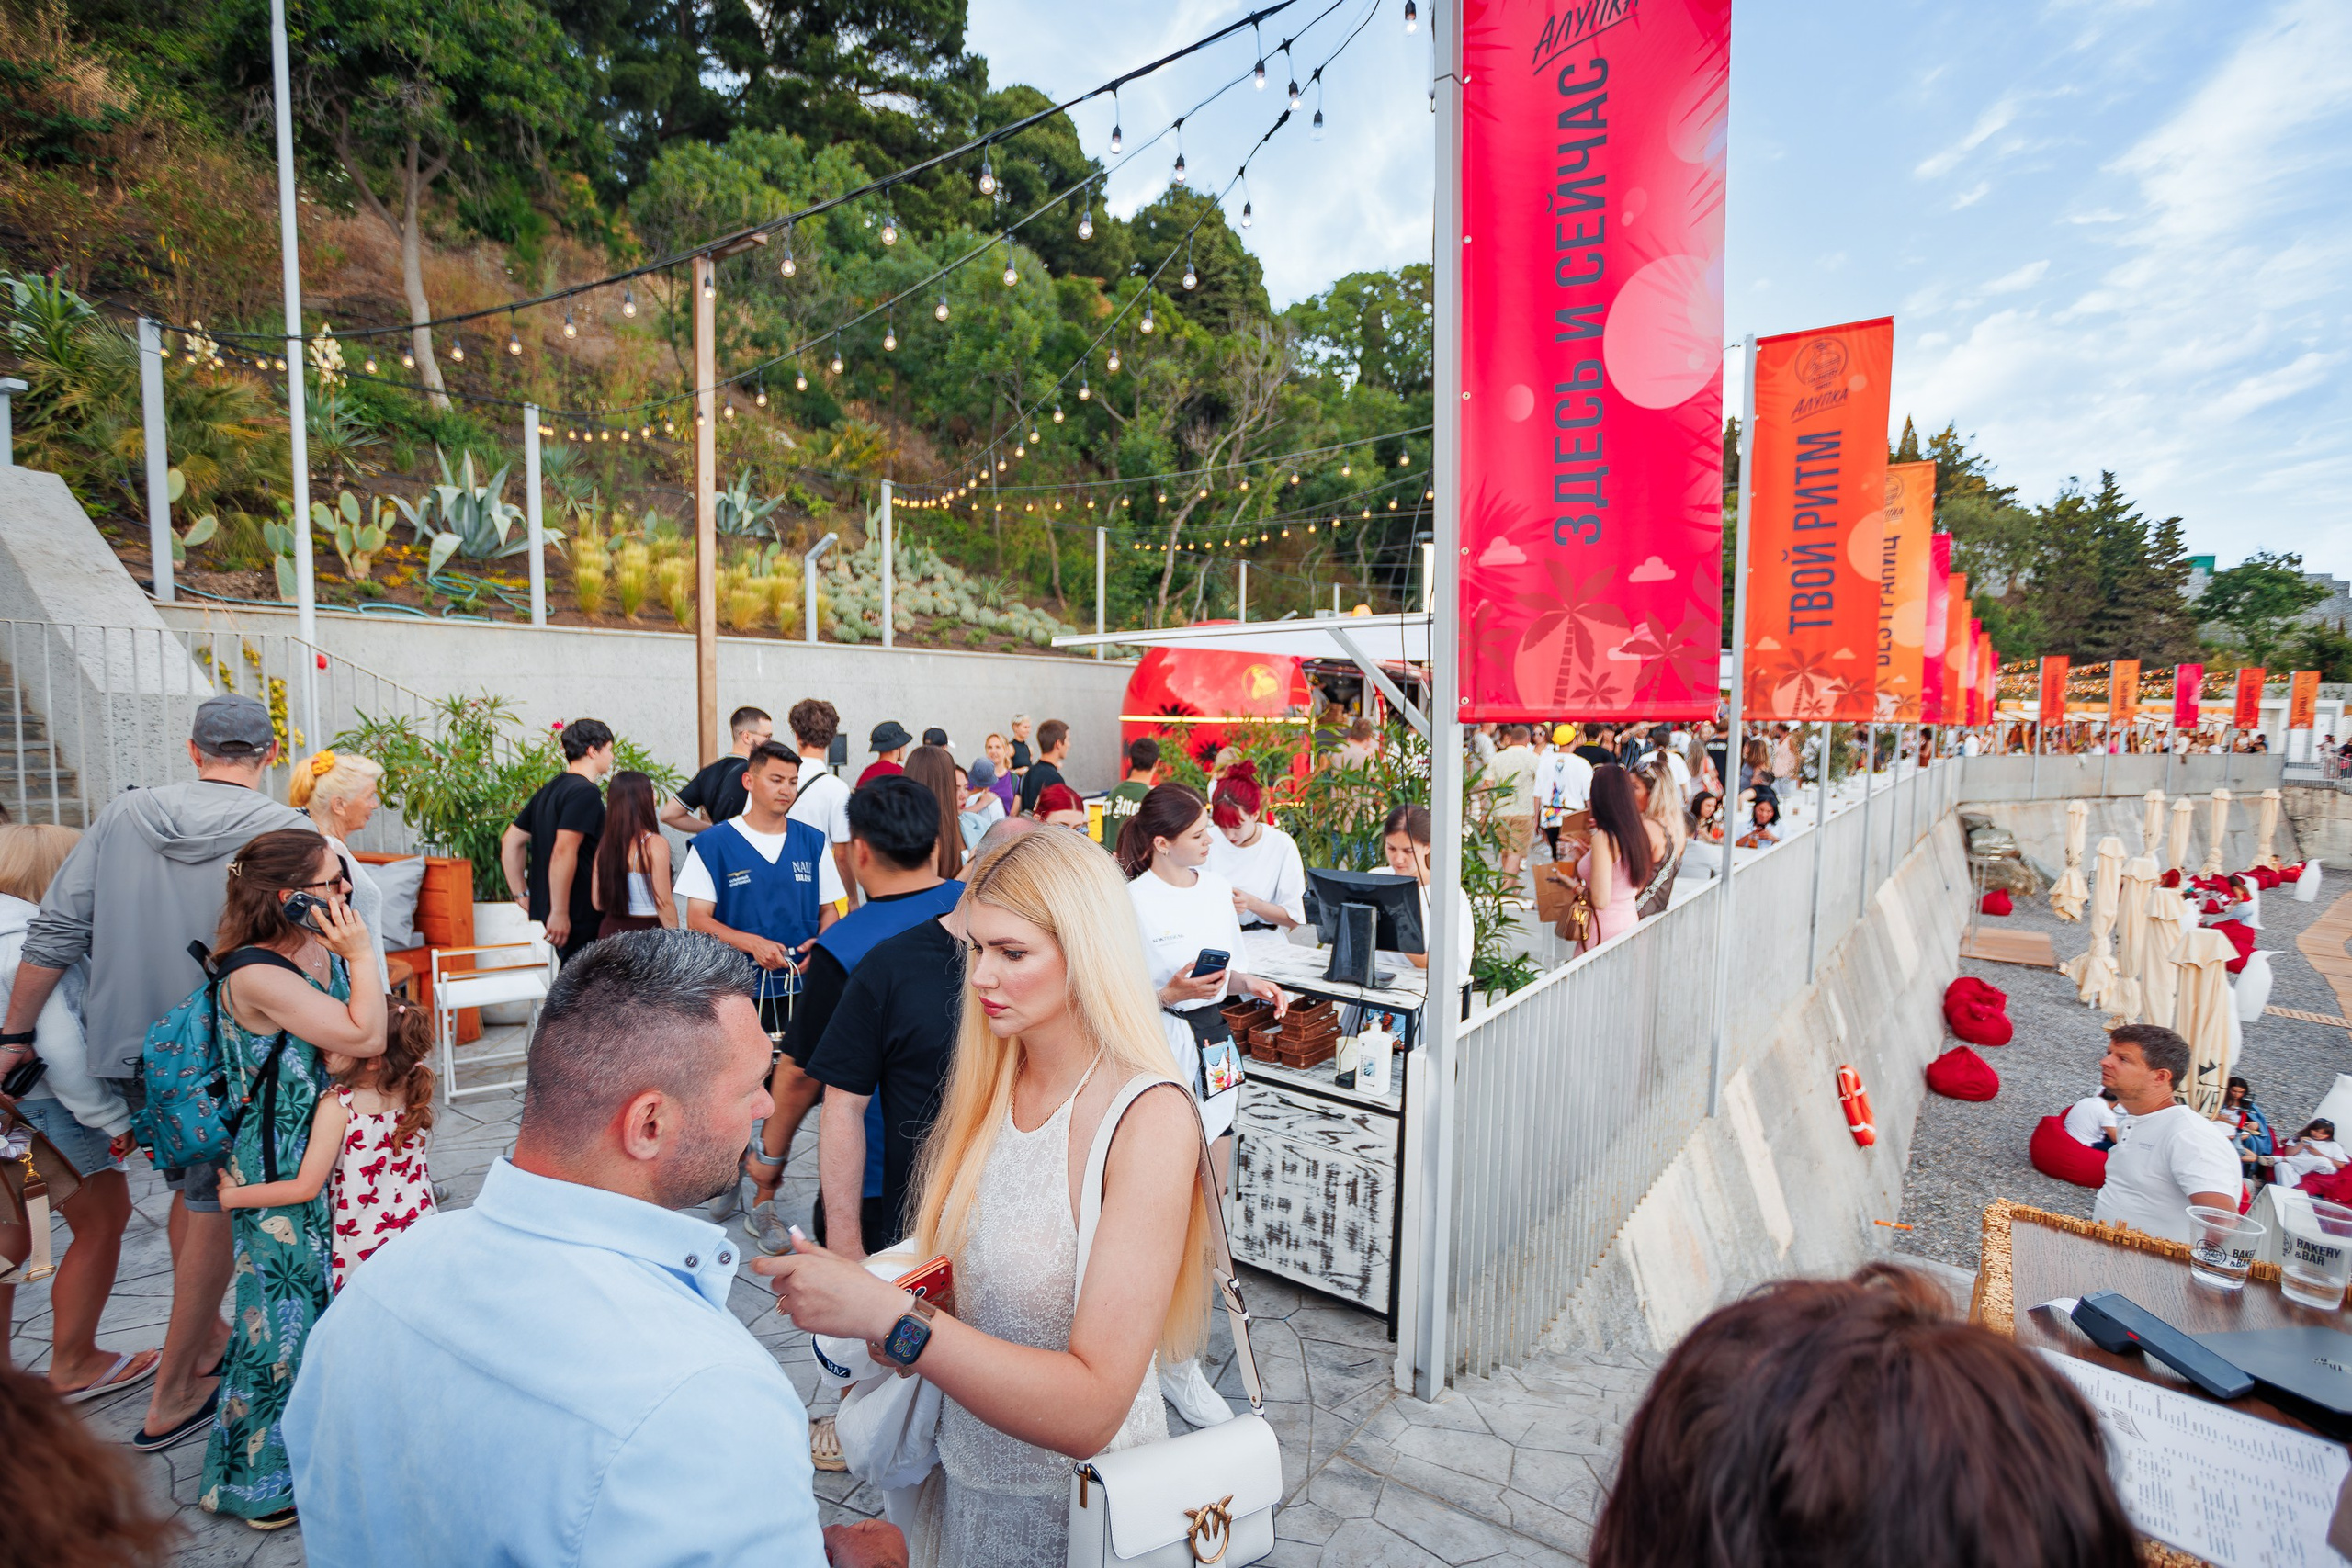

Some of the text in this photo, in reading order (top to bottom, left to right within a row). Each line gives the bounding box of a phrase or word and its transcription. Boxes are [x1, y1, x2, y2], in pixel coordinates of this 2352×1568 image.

[1546, 57, 1609, 547] ЗДЕСЬ И СЕЙЧАС
[1791, 387, 1849, 419] АЛУПКА
[1792, 430, 1842, 531] РИТМ
[1782, 542, 1837, 635] ТВОЙ
[2233, 1248, 2256, 1259] BAKE
[2297, 1237, 2342, 1259] BAKERY
